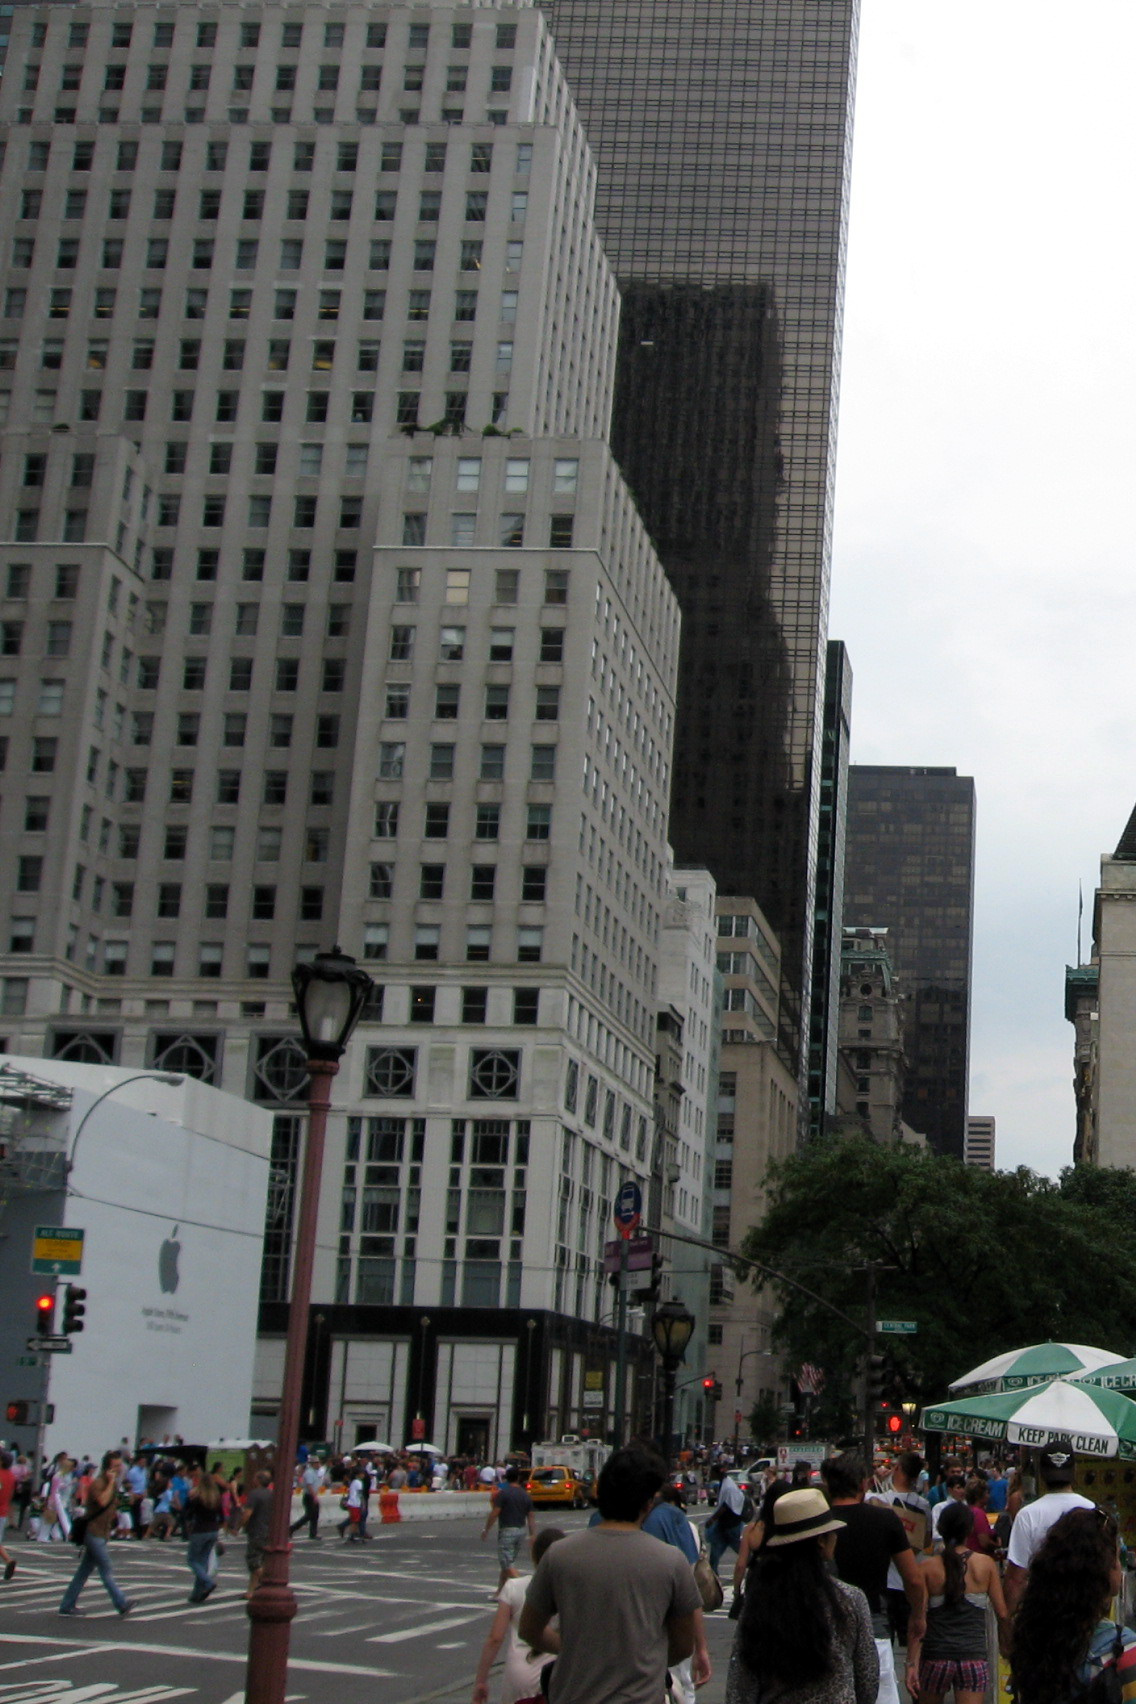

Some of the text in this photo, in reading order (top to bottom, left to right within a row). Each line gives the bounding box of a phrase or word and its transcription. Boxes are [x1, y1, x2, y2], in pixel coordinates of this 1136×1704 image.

[1101, 1376, 1119, 1388] ICE
[947, 1414, 1003, 1438] ICE CREAM
[1018, 1428, 1045, 1445] KEEP
[1076, 1435, 1109, 1455] CLEAN
